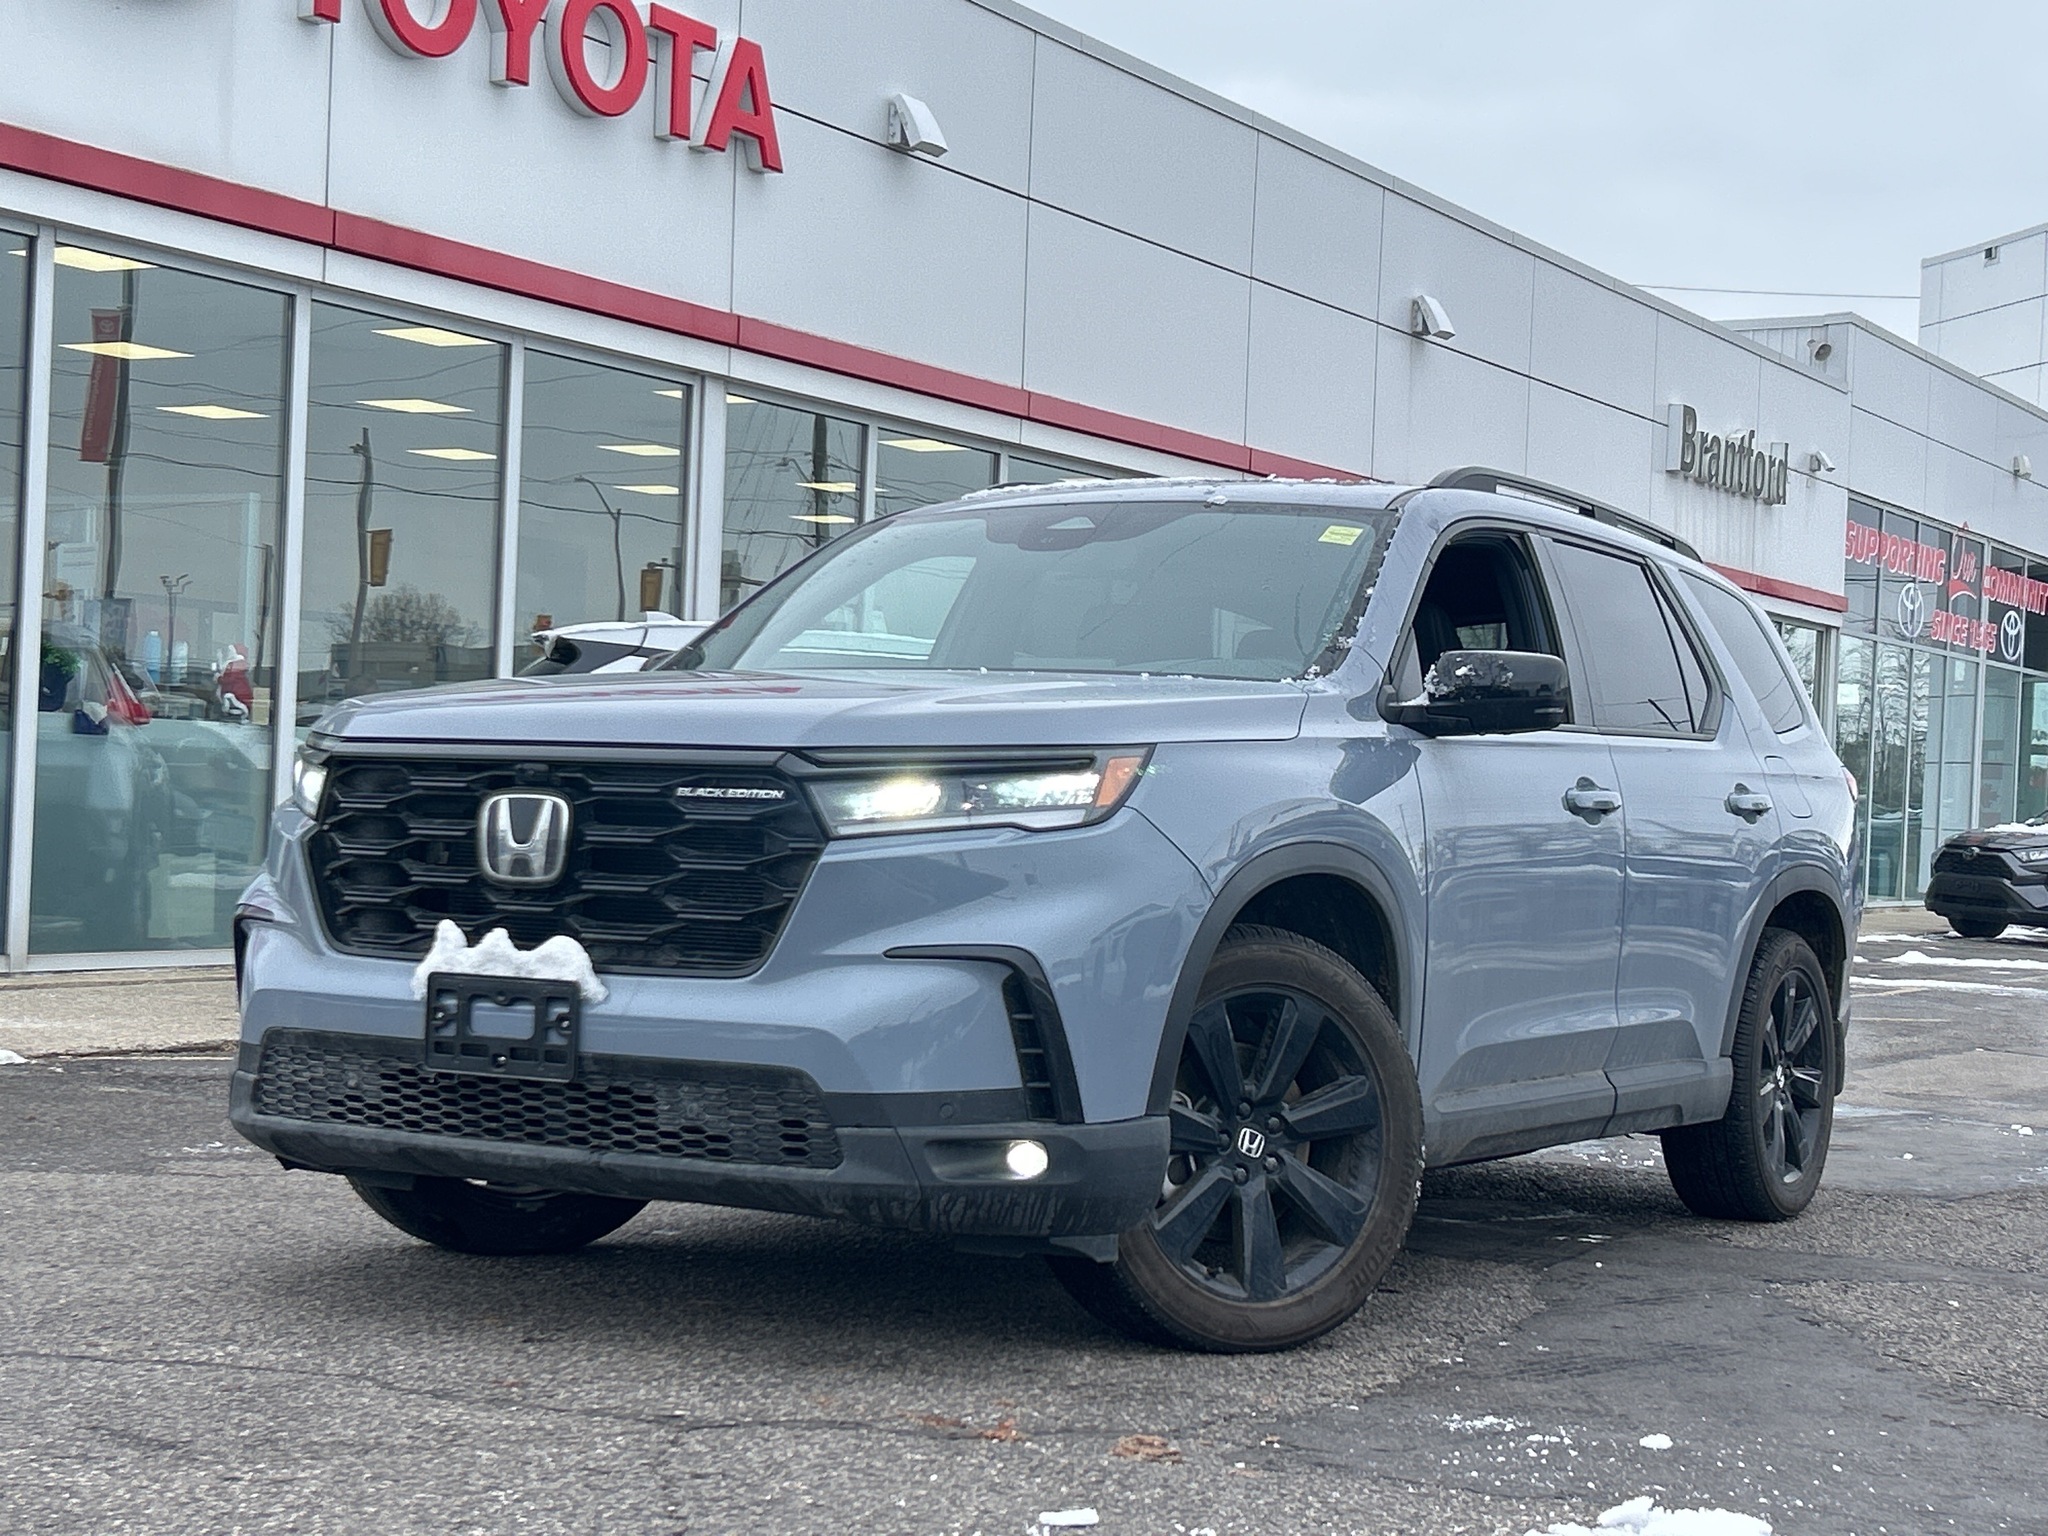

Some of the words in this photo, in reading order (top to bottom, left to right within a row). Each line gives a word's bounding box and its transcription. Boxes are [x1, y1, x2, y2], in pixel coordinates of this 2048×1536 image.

[298, 0, 784, 173] YOTA
[1668, 404, 1789, 505] Brantford
[1845, 520, 1946, 586] SUPPORTING
[1931, 609, 1968, 647] SINCE
[676, 787, 727, 797] BLACK
[726, 788, 785, 799] EDITION
[1344, 1142, 1417, 1299] RIDGESTONE
